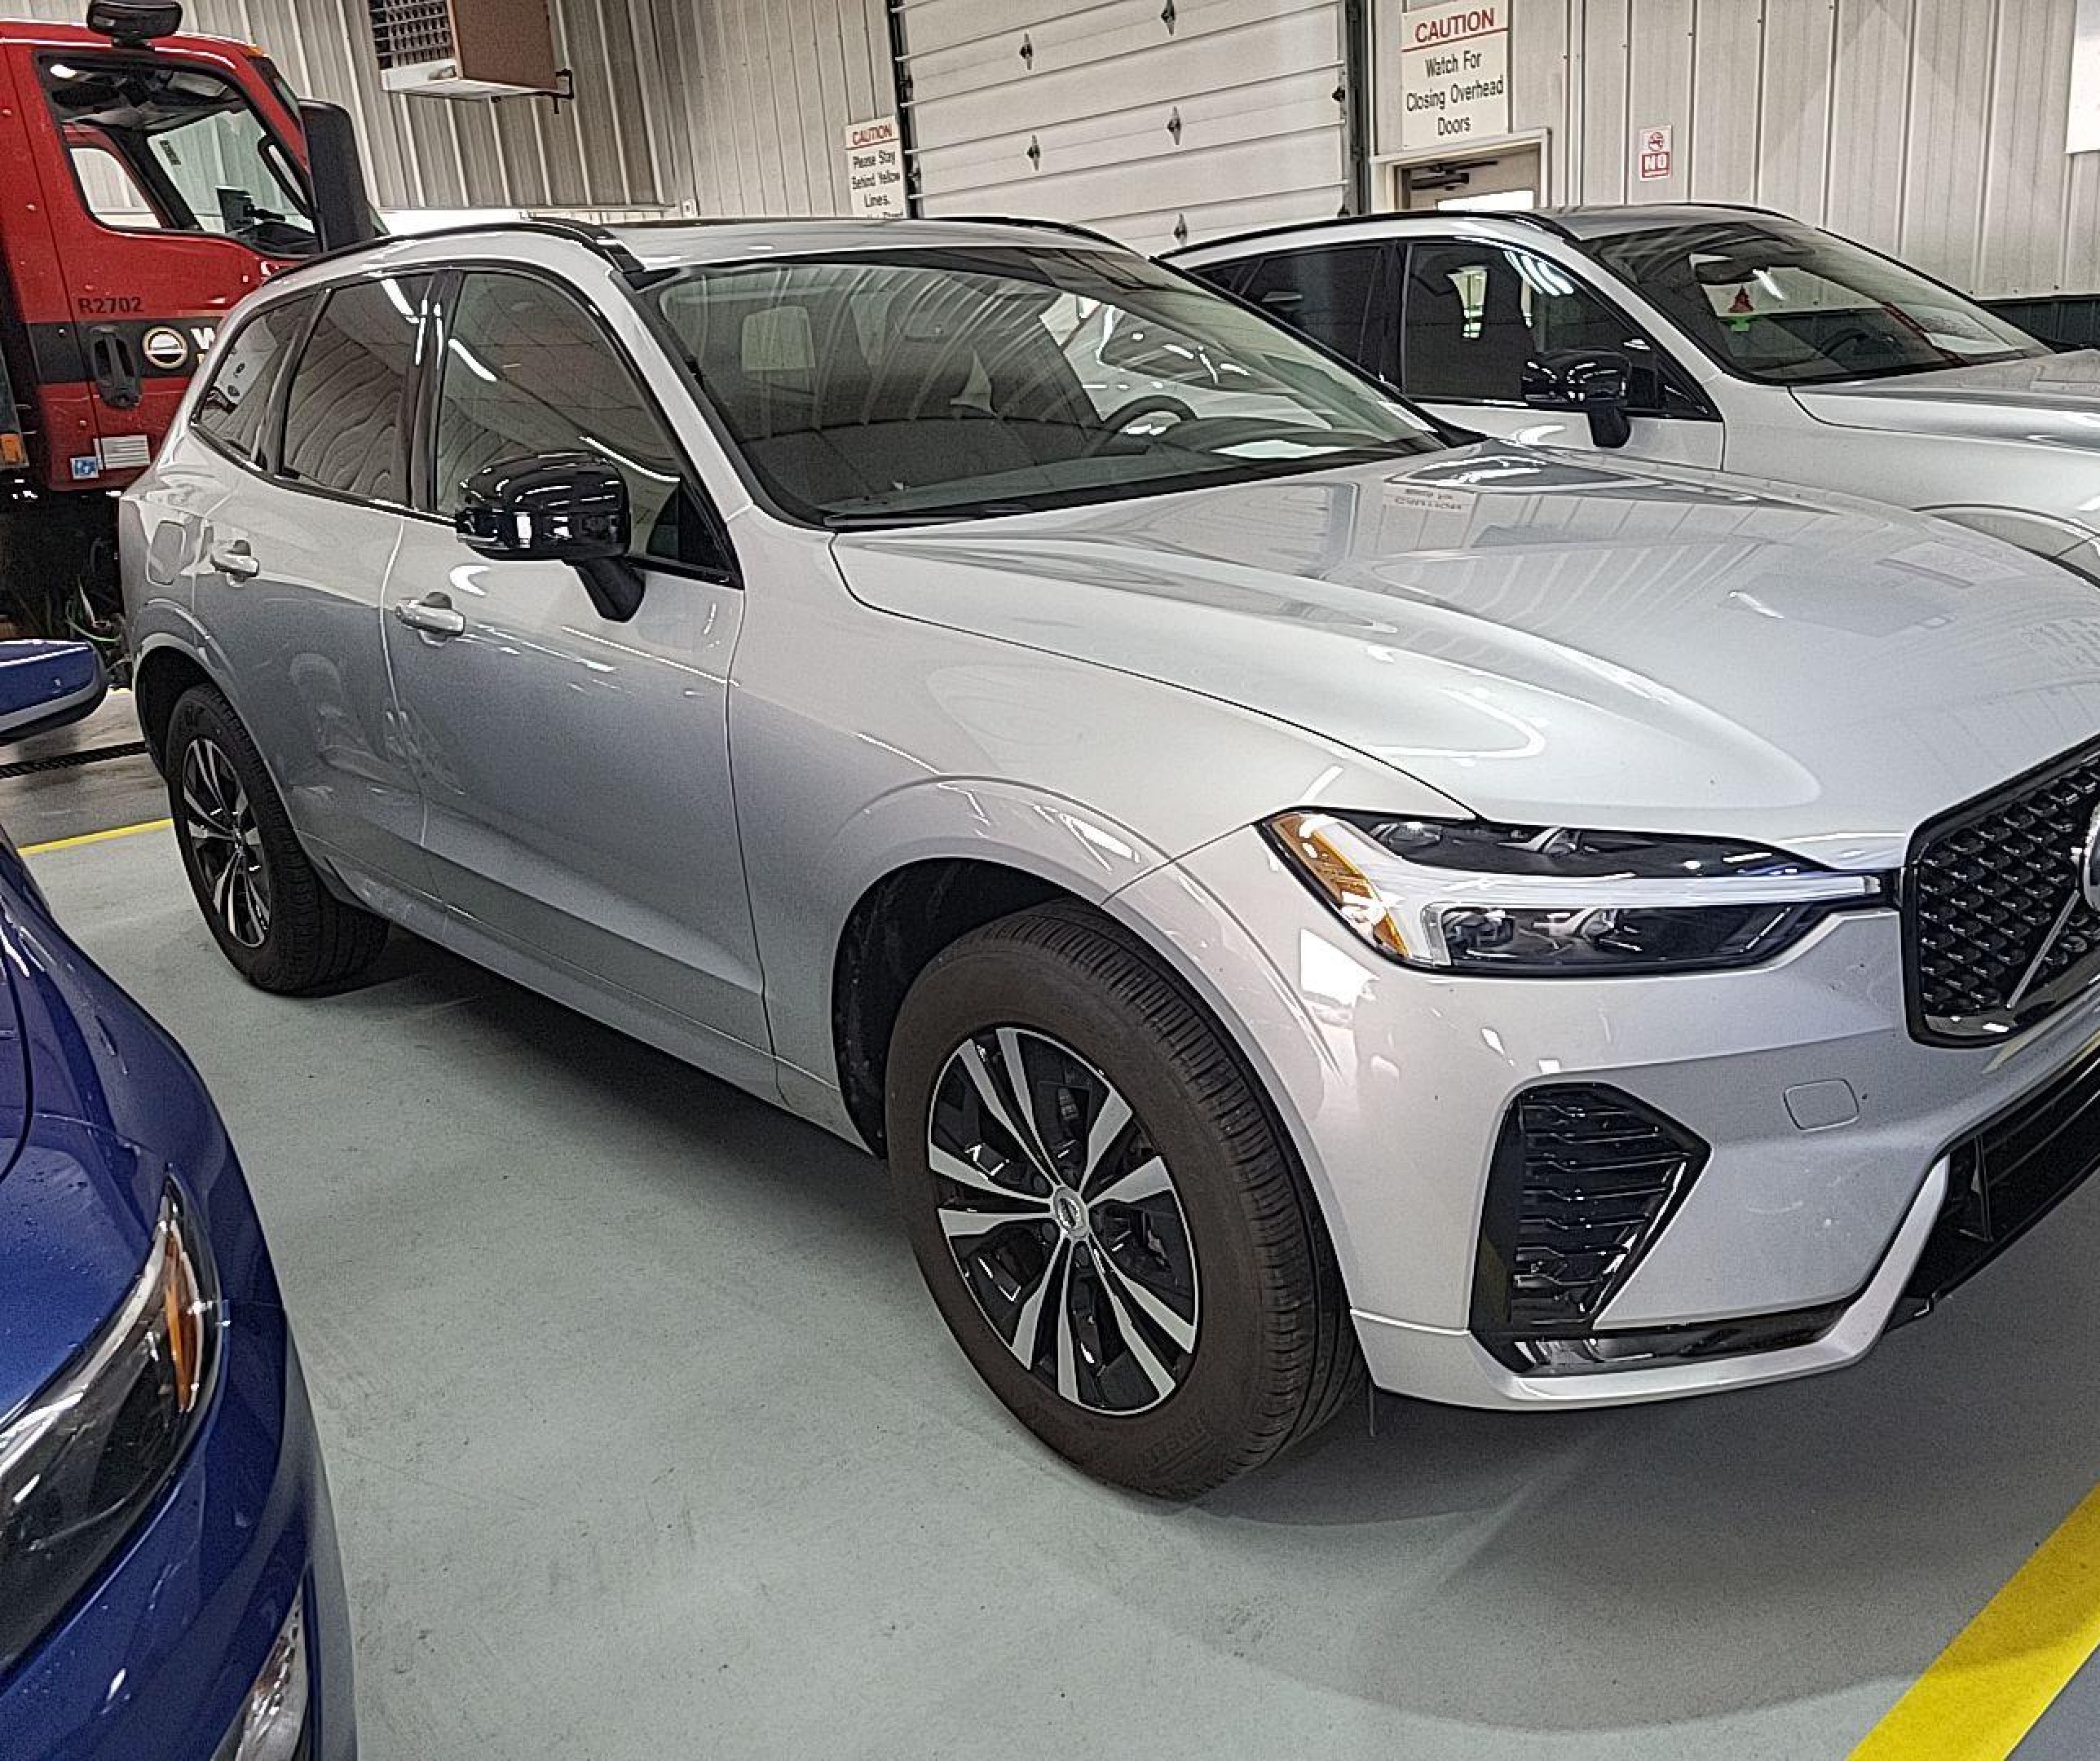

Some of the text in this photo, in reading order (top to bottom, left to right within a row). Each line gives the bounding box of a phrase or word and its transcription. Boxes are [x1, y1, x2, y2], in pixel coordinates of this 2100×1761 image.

[1414, 8, 1494, 42] CAUTION
[1425, 50, 1482, 77] Watch For
[1406, 74, 1504, 111] Closing Overhead
[852, 123, 893, 145] CAUTION
[1437, 117, 1471, 135] Doors
[852, 149, 896, 170] Please Stay
[851, 169, 901, 190] Behind Yellow
[77, 296, 144, 314] R2702
